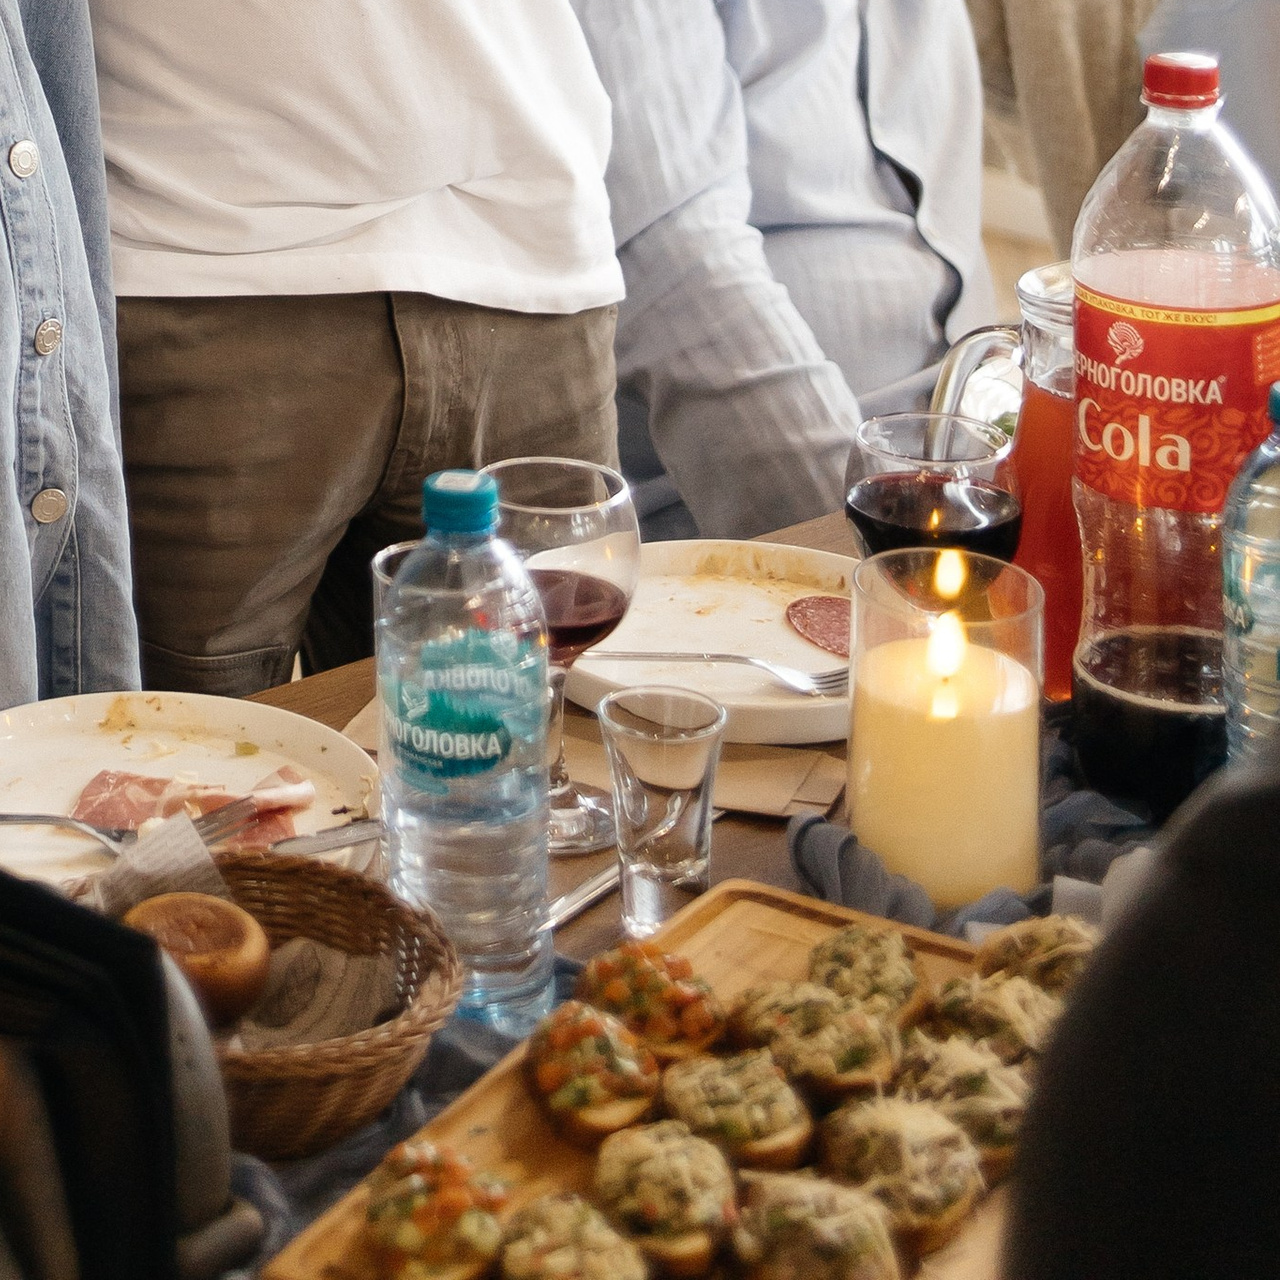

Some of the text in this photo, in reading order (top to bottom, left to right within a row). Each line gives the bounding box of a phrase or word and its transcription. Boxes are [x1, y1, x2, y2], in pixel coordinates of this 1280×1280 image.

[1140, 308, 1160, 320] ТОТ
[1163, 312, 1181, 323] ЖЕ
[1075, 350, 1223, 405] ЕРНОГОЛОВКА
[1078, 397, 1191, 472] Cola
